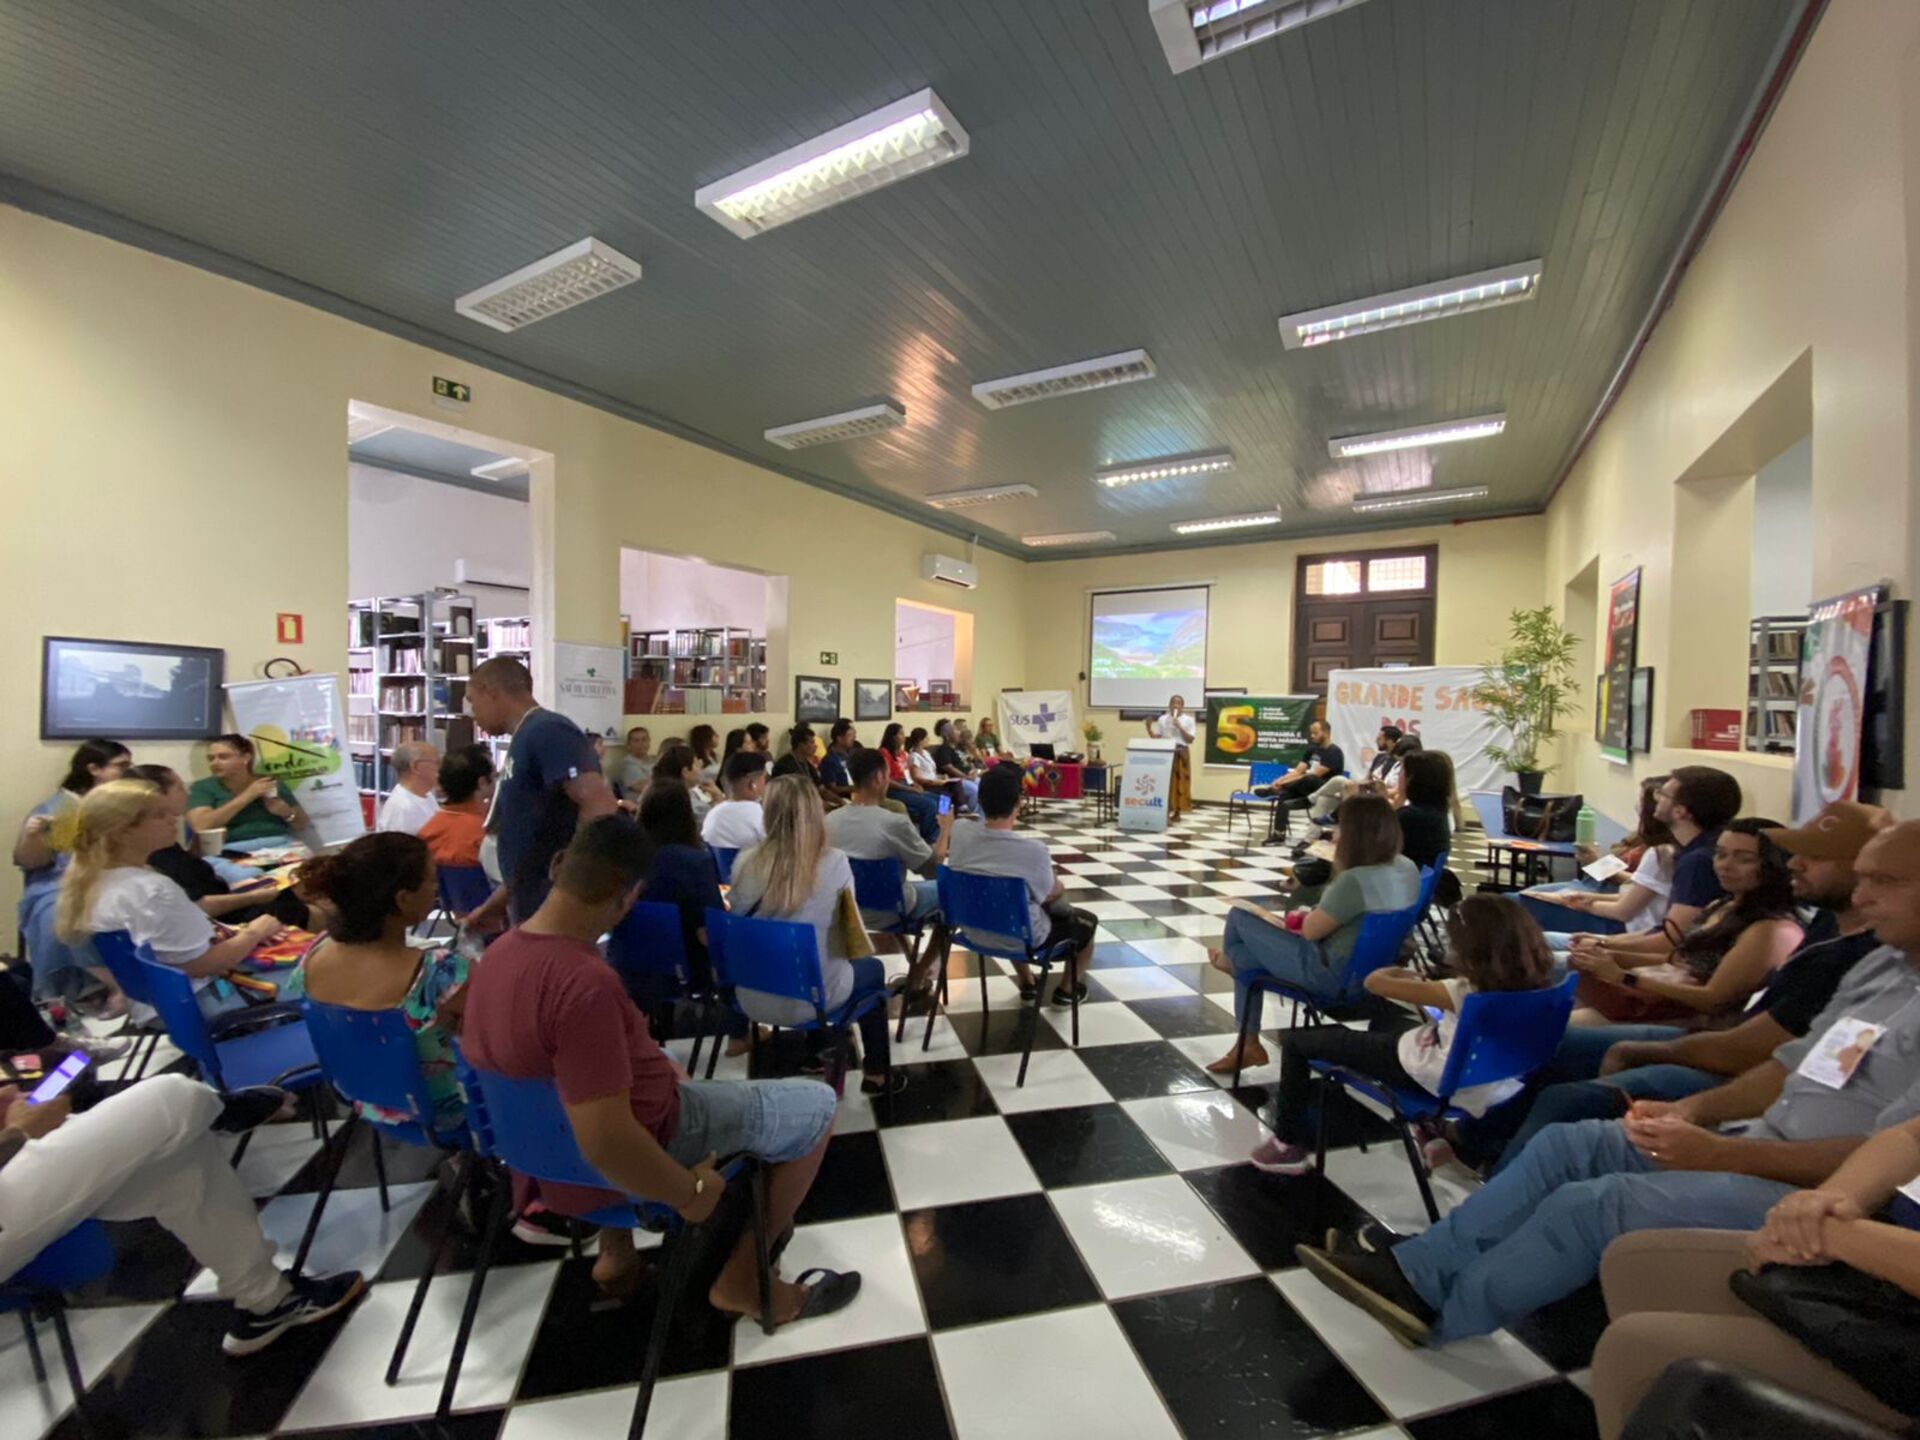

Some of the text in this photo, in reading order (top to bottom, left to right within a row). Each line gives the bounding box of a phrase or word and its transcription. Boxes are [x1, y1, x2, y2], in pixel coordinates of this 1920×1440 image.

[1335, 681, 1425, 712] GRANDE
[1009, 713, 1030, 726] SUS
[1216, 705, 1257, 753] 5
[1124, 796, 1163, 808] secult
